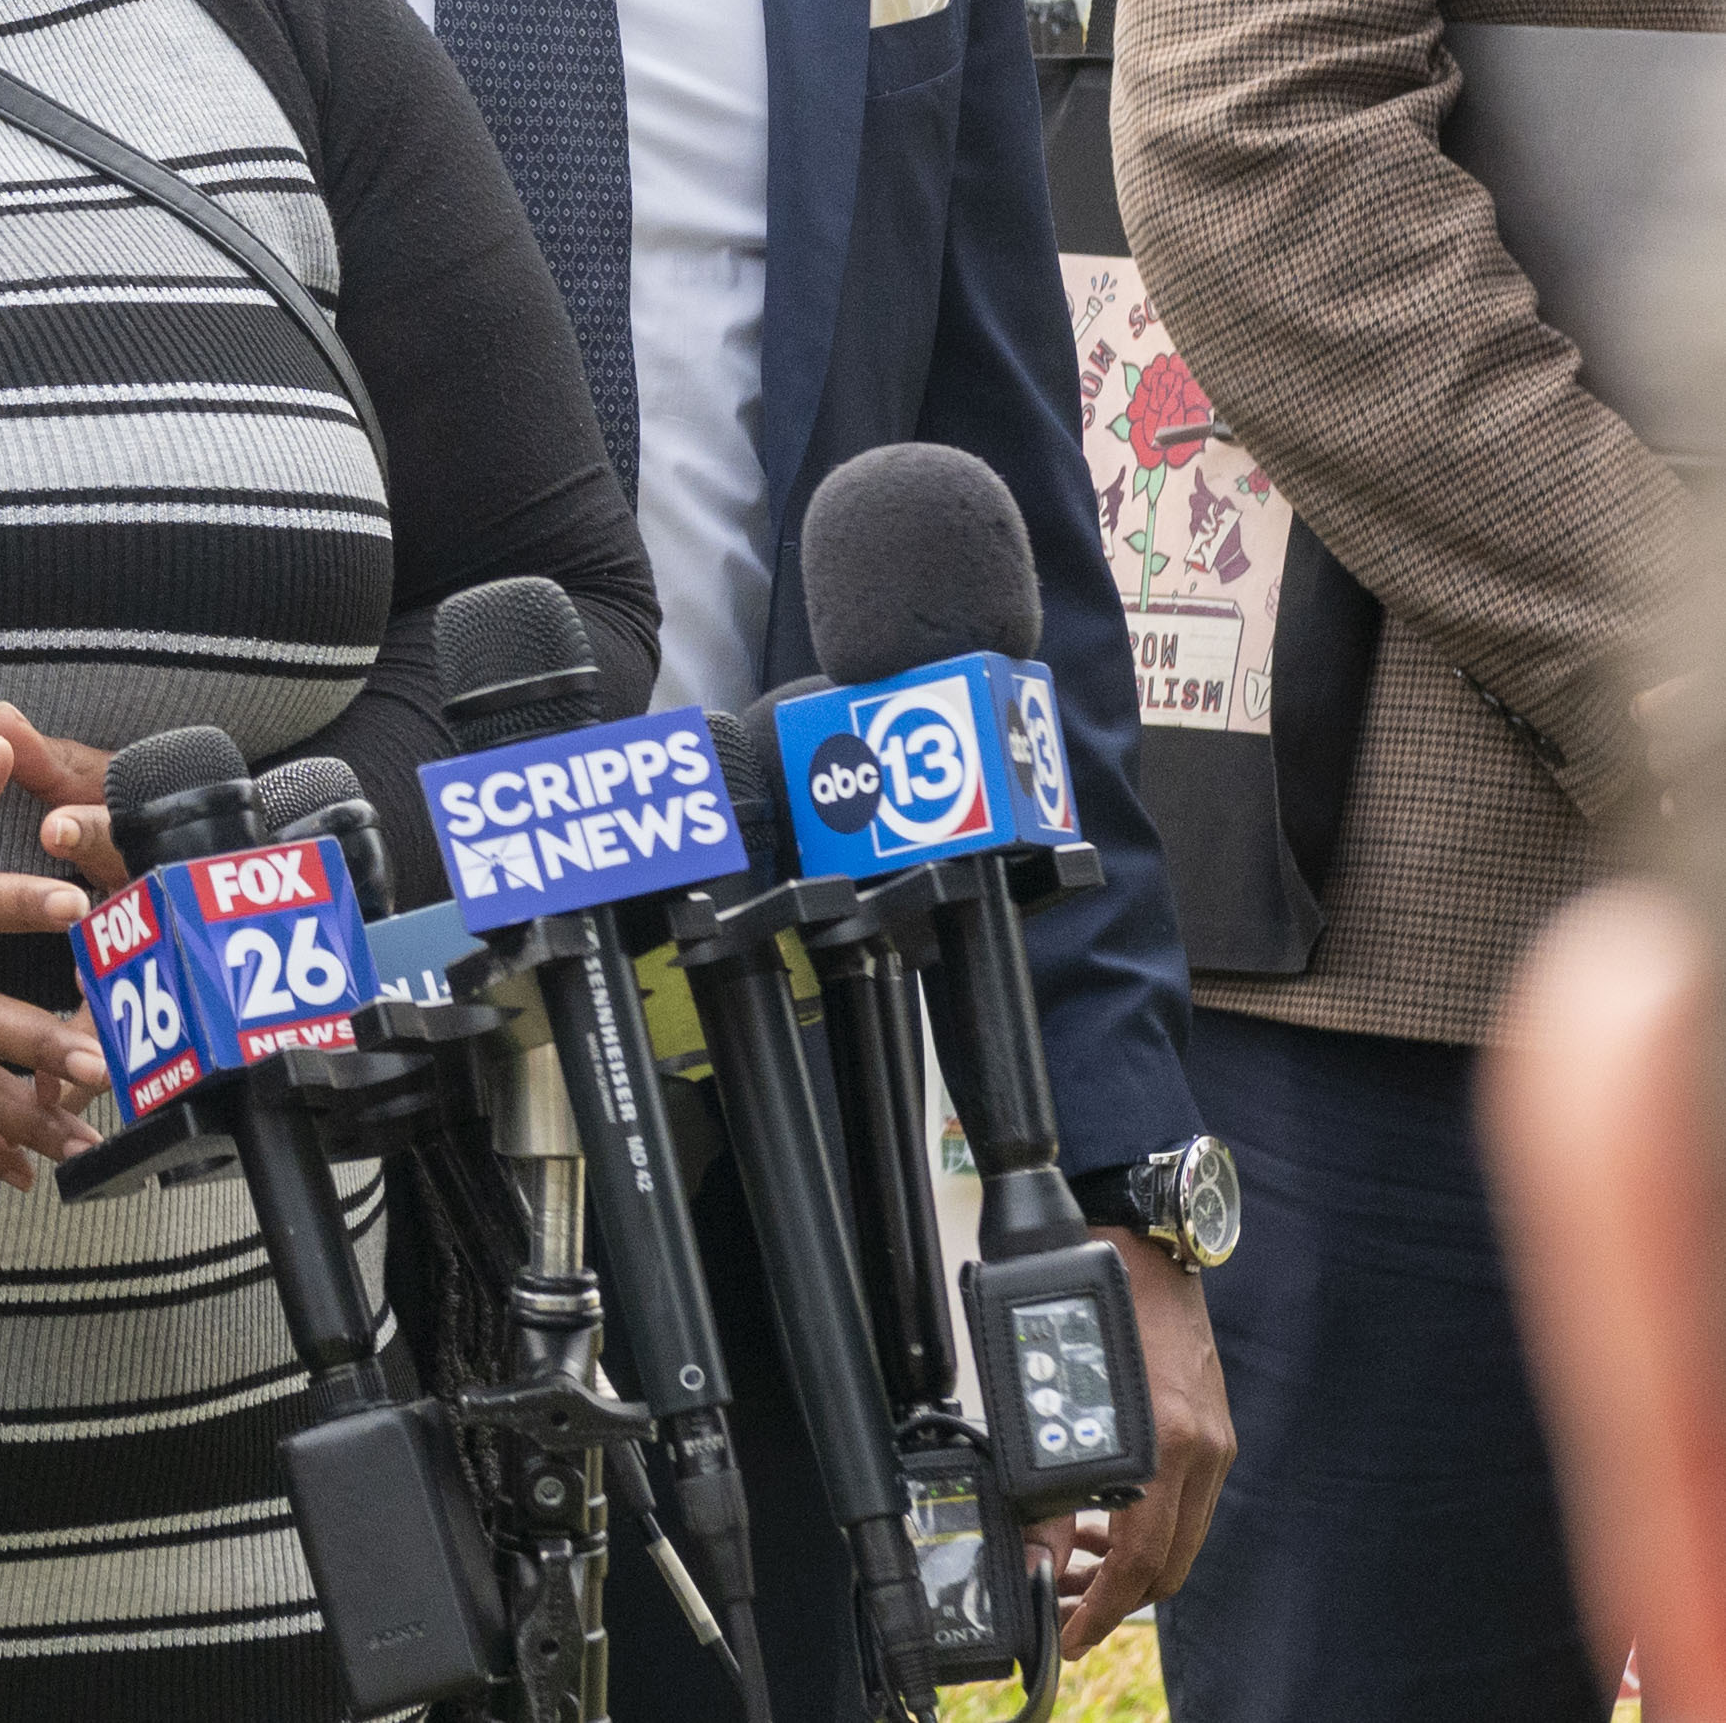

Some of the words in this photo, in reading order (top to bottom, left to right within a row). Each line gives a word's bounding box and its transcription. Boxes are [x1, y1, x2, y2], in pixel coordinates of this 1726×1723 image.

[440, 730, 711, 837] SCRIPPS
[811, 762, 880, 805] abc
[880, 722, 965, 807] 13
[535, 790, 729, 881] NEWS
[208, 849, 316, 913] FOX
[90, 889, 152, 967] FOX
[225, 915, 348, 1020] 26
[110, 958, 181, 1074] 26
[248, 1018, 355, 1057] NEWS
[583, 957, 638, 1123] SENNHEISER
[134, 1058, 195, 1110] NEWS
